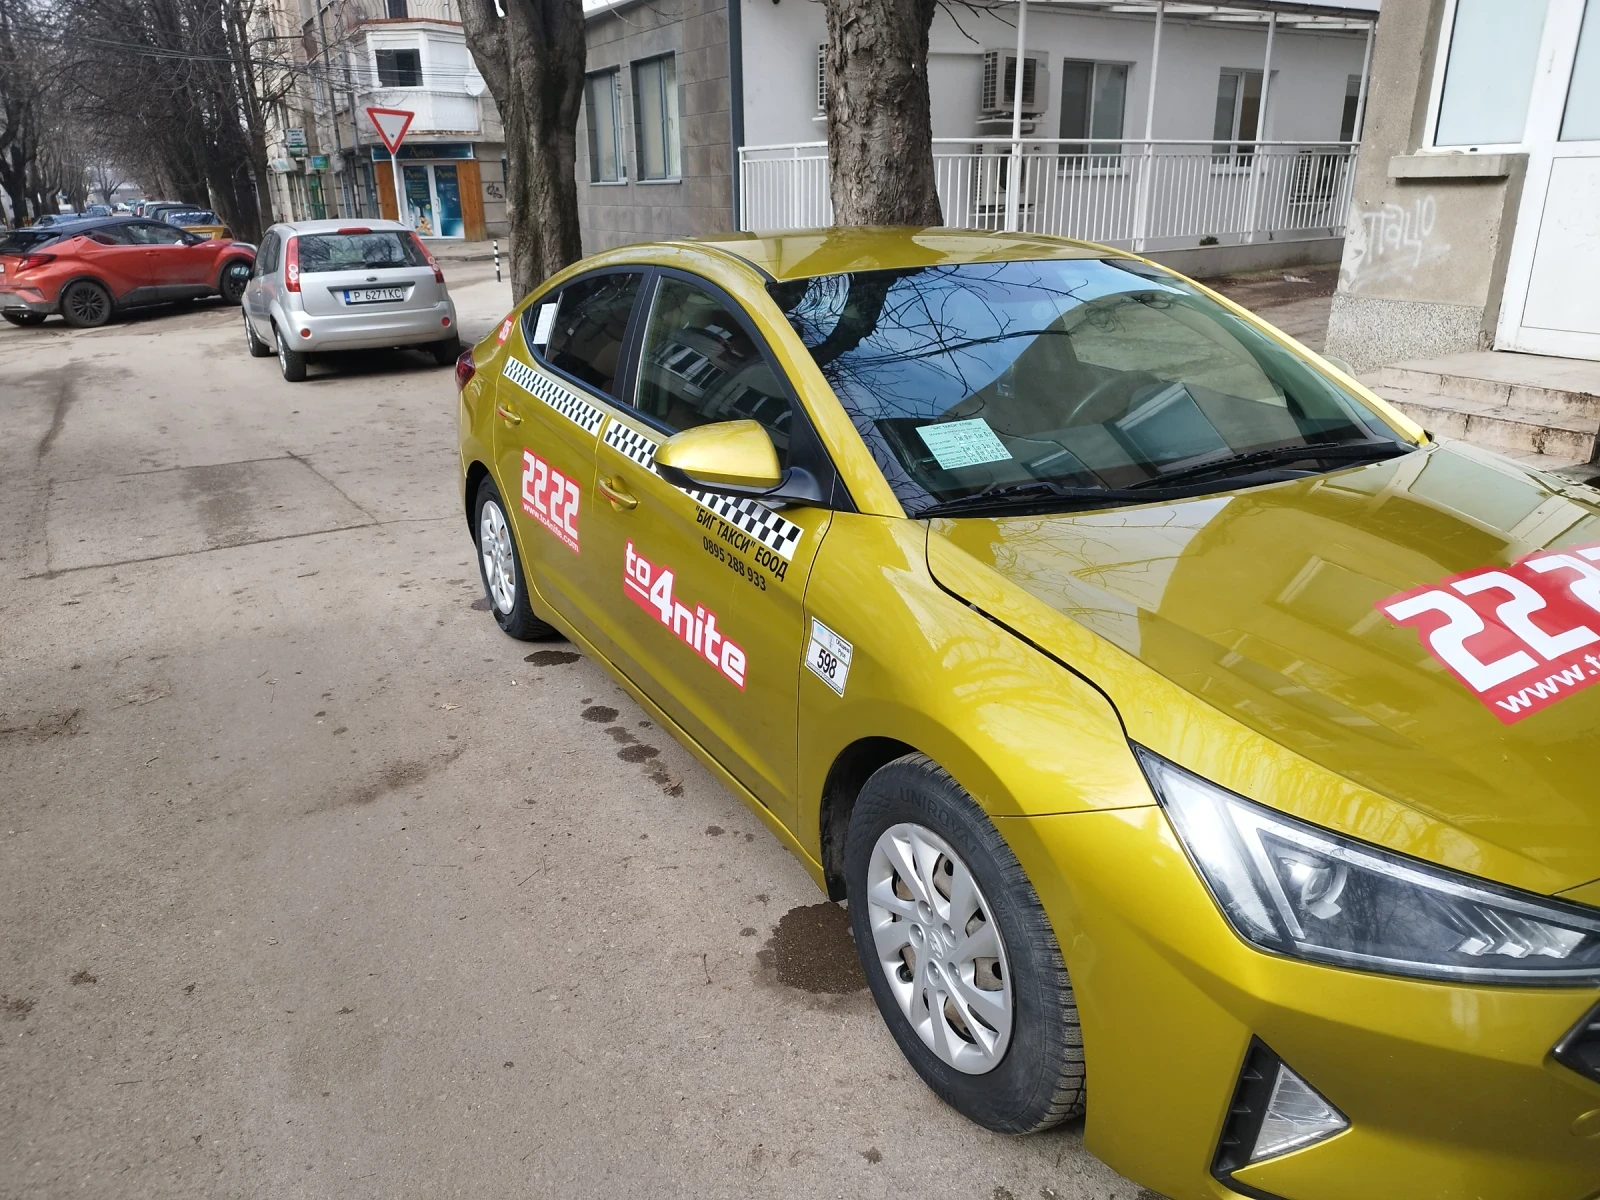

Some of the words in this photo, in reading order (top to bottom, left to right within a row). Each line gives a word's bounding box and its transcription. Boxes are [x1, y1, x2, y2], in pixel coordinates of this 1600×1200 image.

[353, 291, 361, 300] P
[365, 289, 401, 300] 6271KC
[523, 502, 580, 553] www.to4nite.com
[695, 505, 718, 531] "БИГ
[716, 521, 757, 554] ТАКСИ"
[754, 546, 789, 582] ЕООД
[703, 536, 725, 563] 0895
[727, 552, 746, 577] 288
[747, 567, 767, 591] 933
[625, 541, 747, 687] to4nite
[817, 648, 837, 679] 598
[1495, 653, 1600, 714] www.t
[899, 786, 978, 858] UNIROYAL
